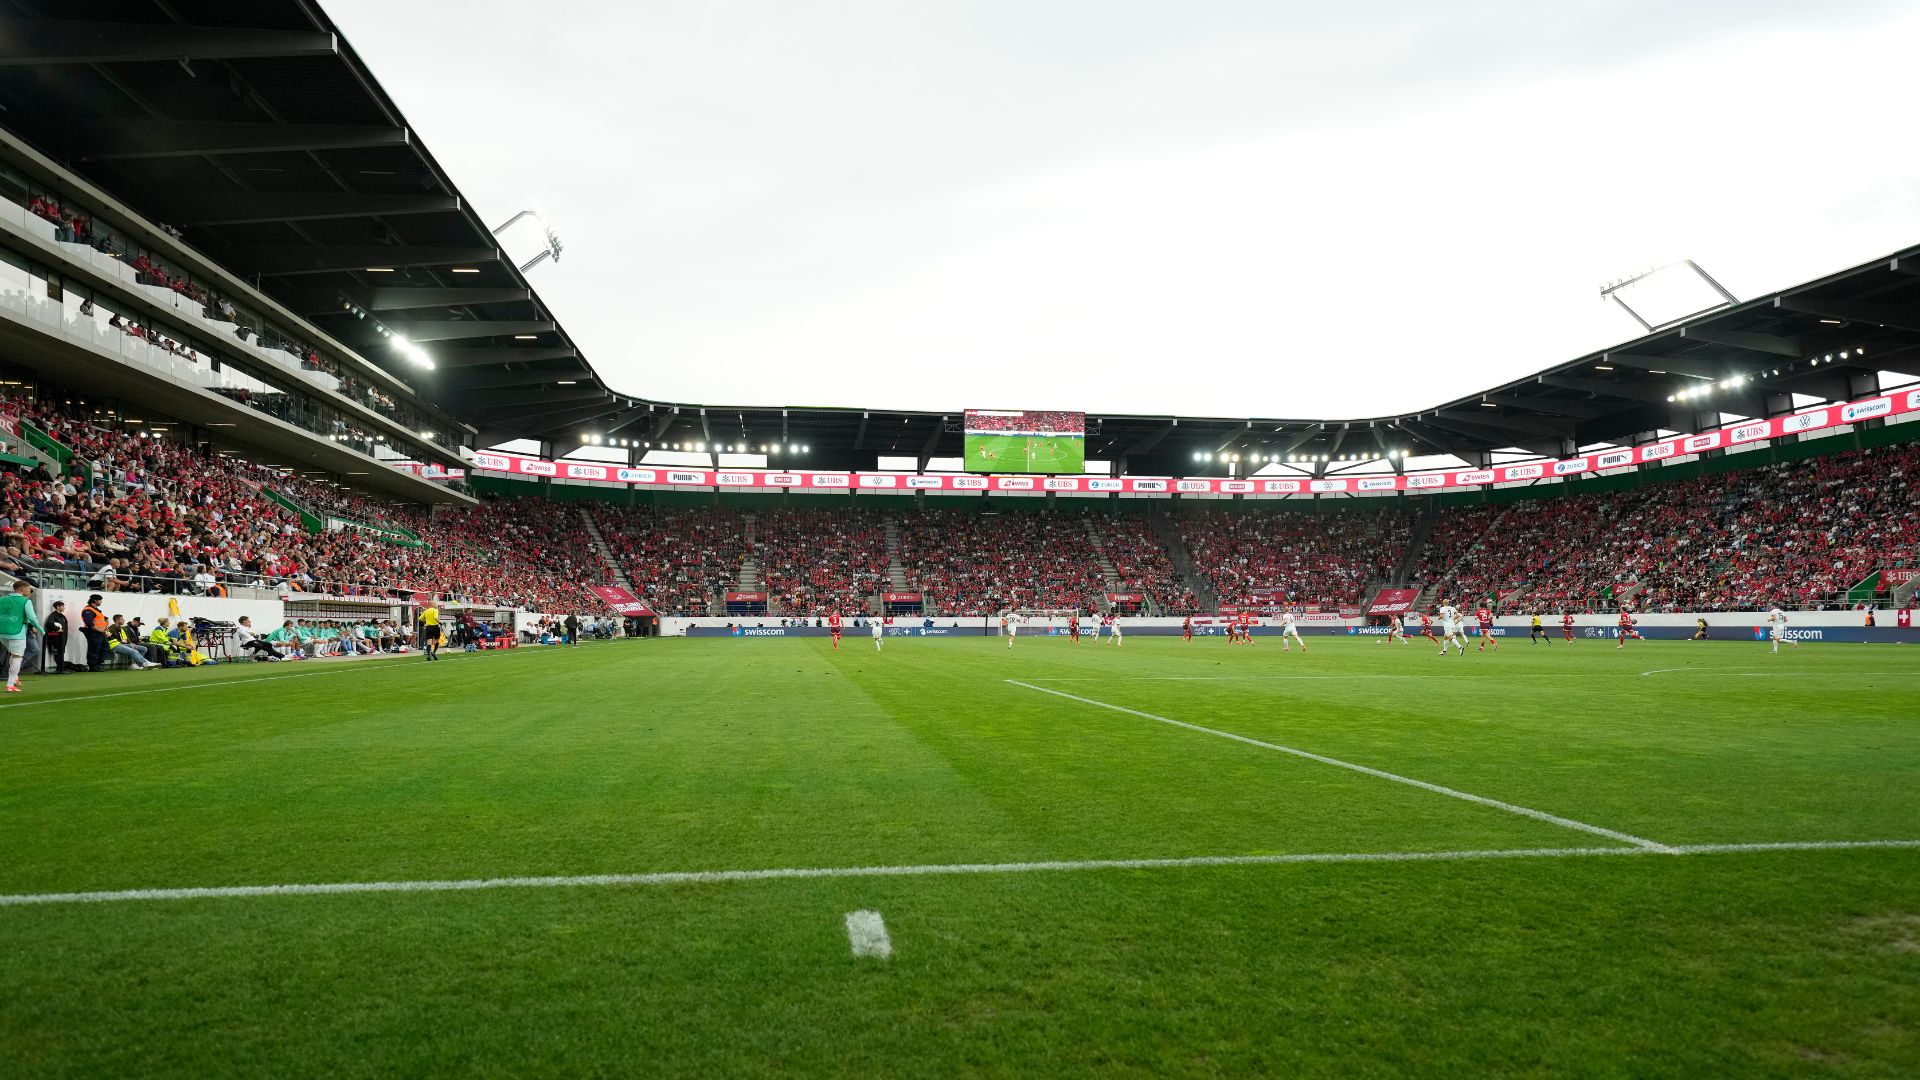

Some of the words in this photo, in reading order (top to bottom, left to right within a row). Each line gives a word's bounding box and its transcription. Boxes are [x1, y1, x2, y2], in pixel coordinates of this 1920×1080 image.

[1856, 402, 1886, 414] swisscom
[1746, 426, 1764, 437] UBS
[1654, 446, 1669, 456] UBS
[488, 457, 504, 467] UBS
[1602, 454, 1620, 464] PUMA
[1566, 462, 1585, 470] ZURICH
[584, 468, 600, 476] UBS
[1520, 468, 1536, 476] UBS
[745, 628, 784, 636] swisscom
